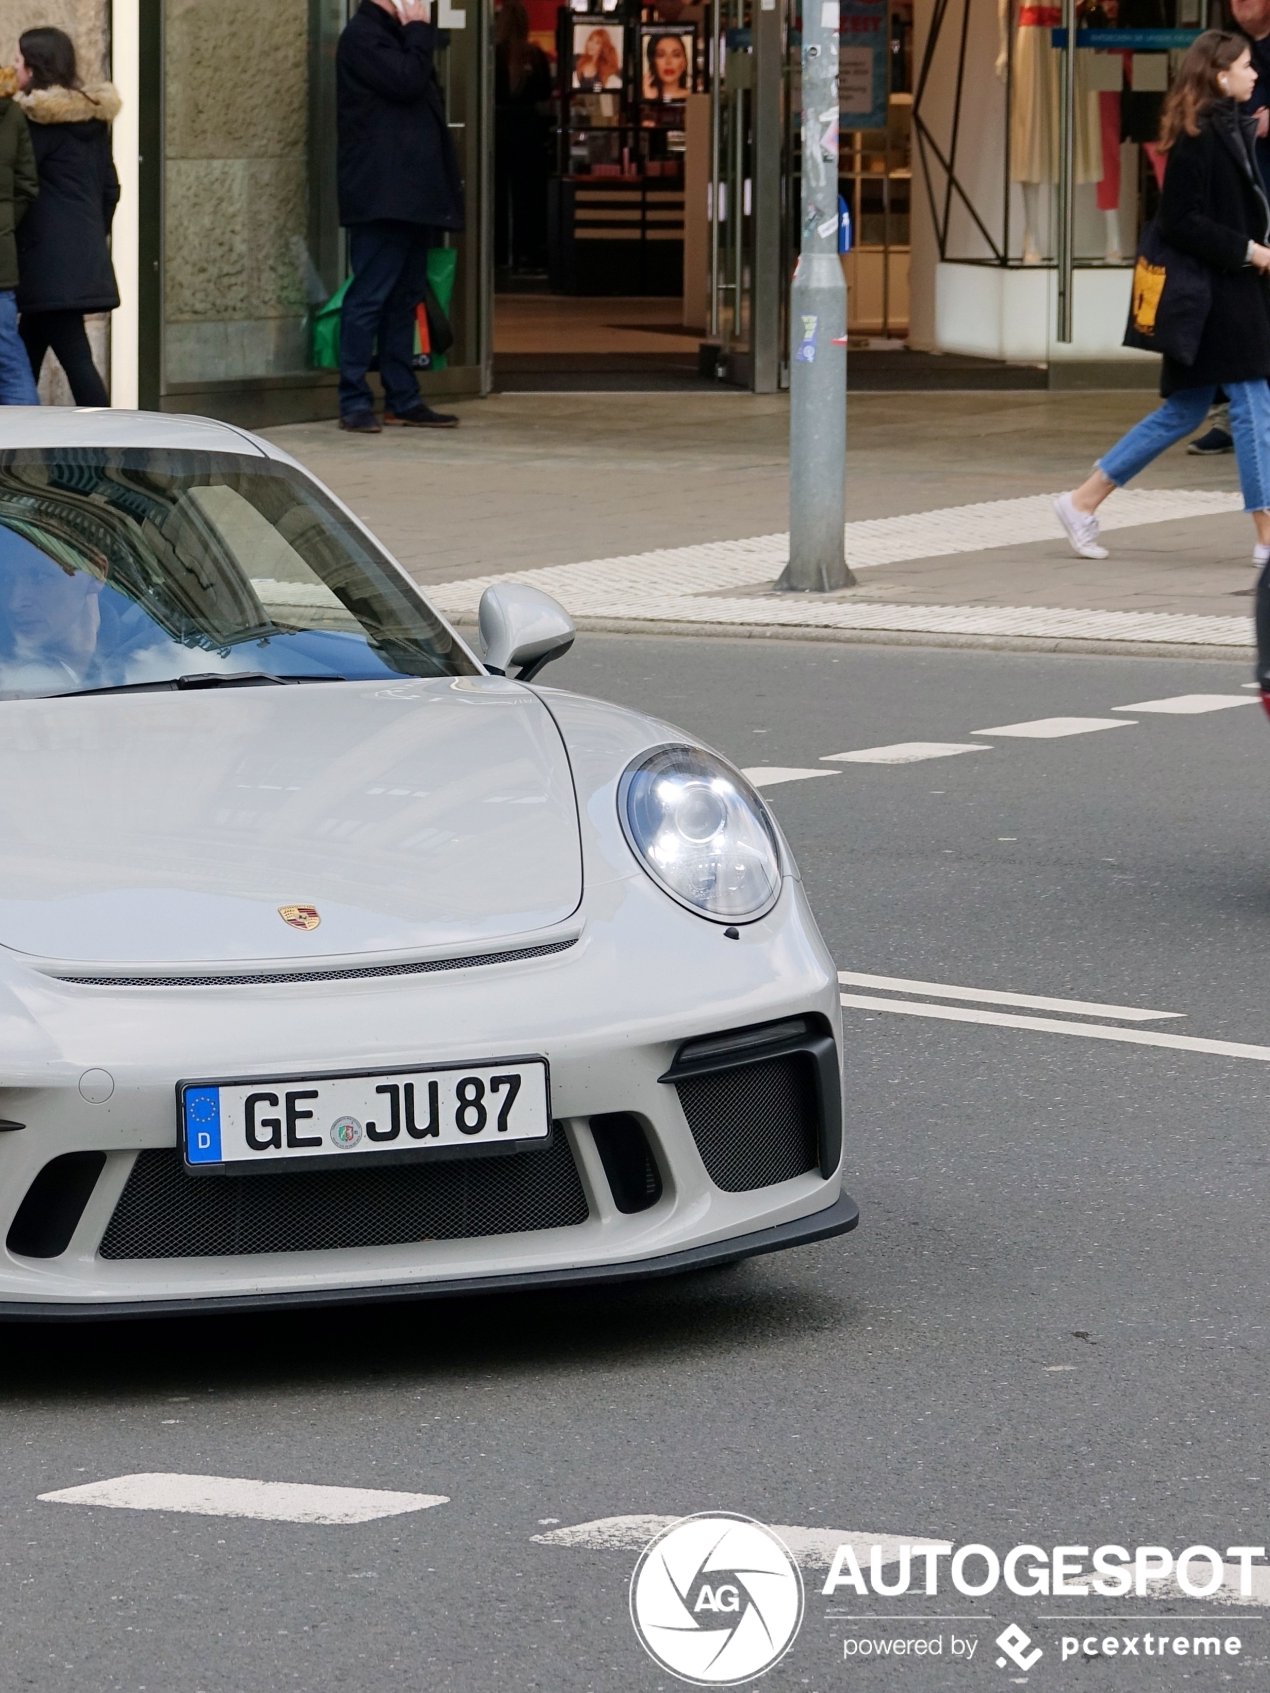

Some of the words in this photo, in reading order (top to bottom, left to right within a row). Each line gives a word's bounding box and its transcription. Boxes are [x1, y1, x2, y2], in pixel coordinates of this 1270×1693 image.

[197, 1132, 211, 1149] D
[244, 1089, 323, 1151] GE
[365, 1080, 440, 1143] JU
[455, 1073, 522, 1136] 87
